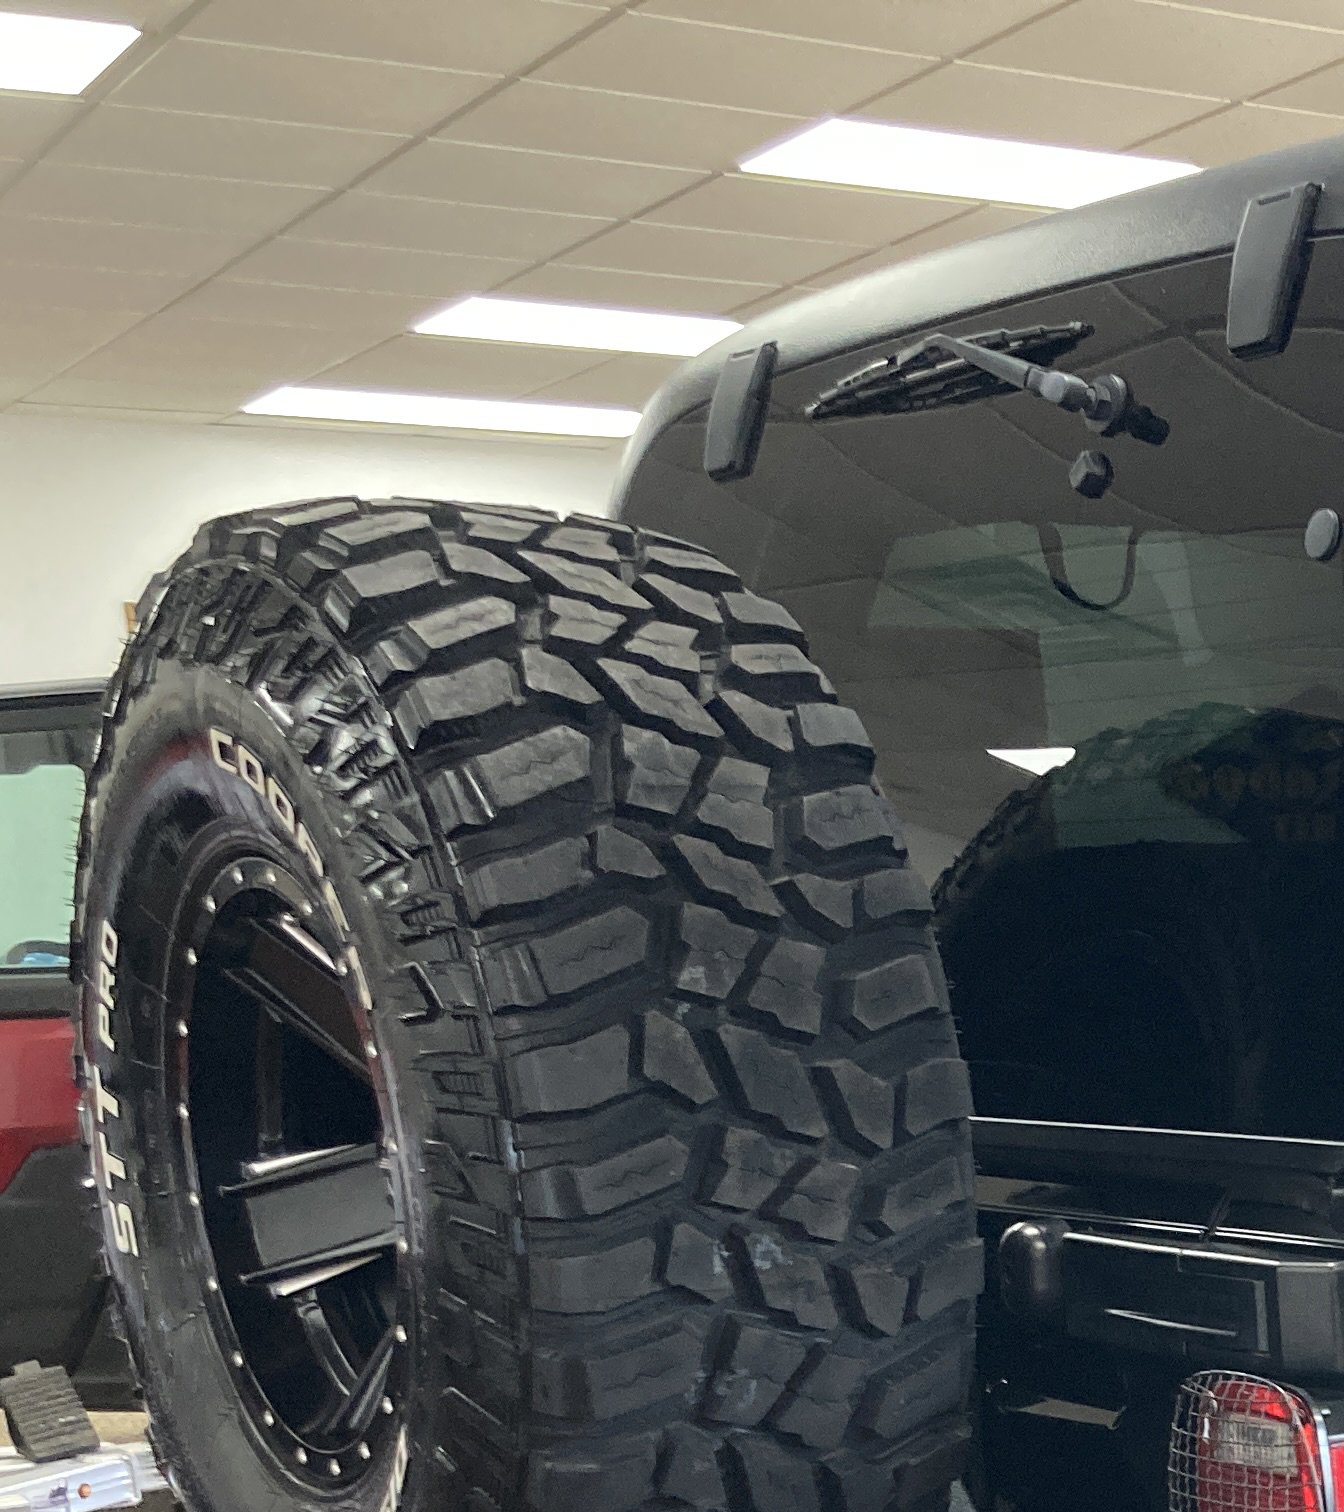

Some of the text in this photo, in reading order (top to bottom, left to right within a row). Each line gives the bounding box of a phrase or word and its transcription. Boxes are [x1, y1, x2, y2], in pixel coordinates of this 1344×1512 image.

[209, 727, 373, 1010] COOPER
[95, 919, 139, 1257] STT PRO
